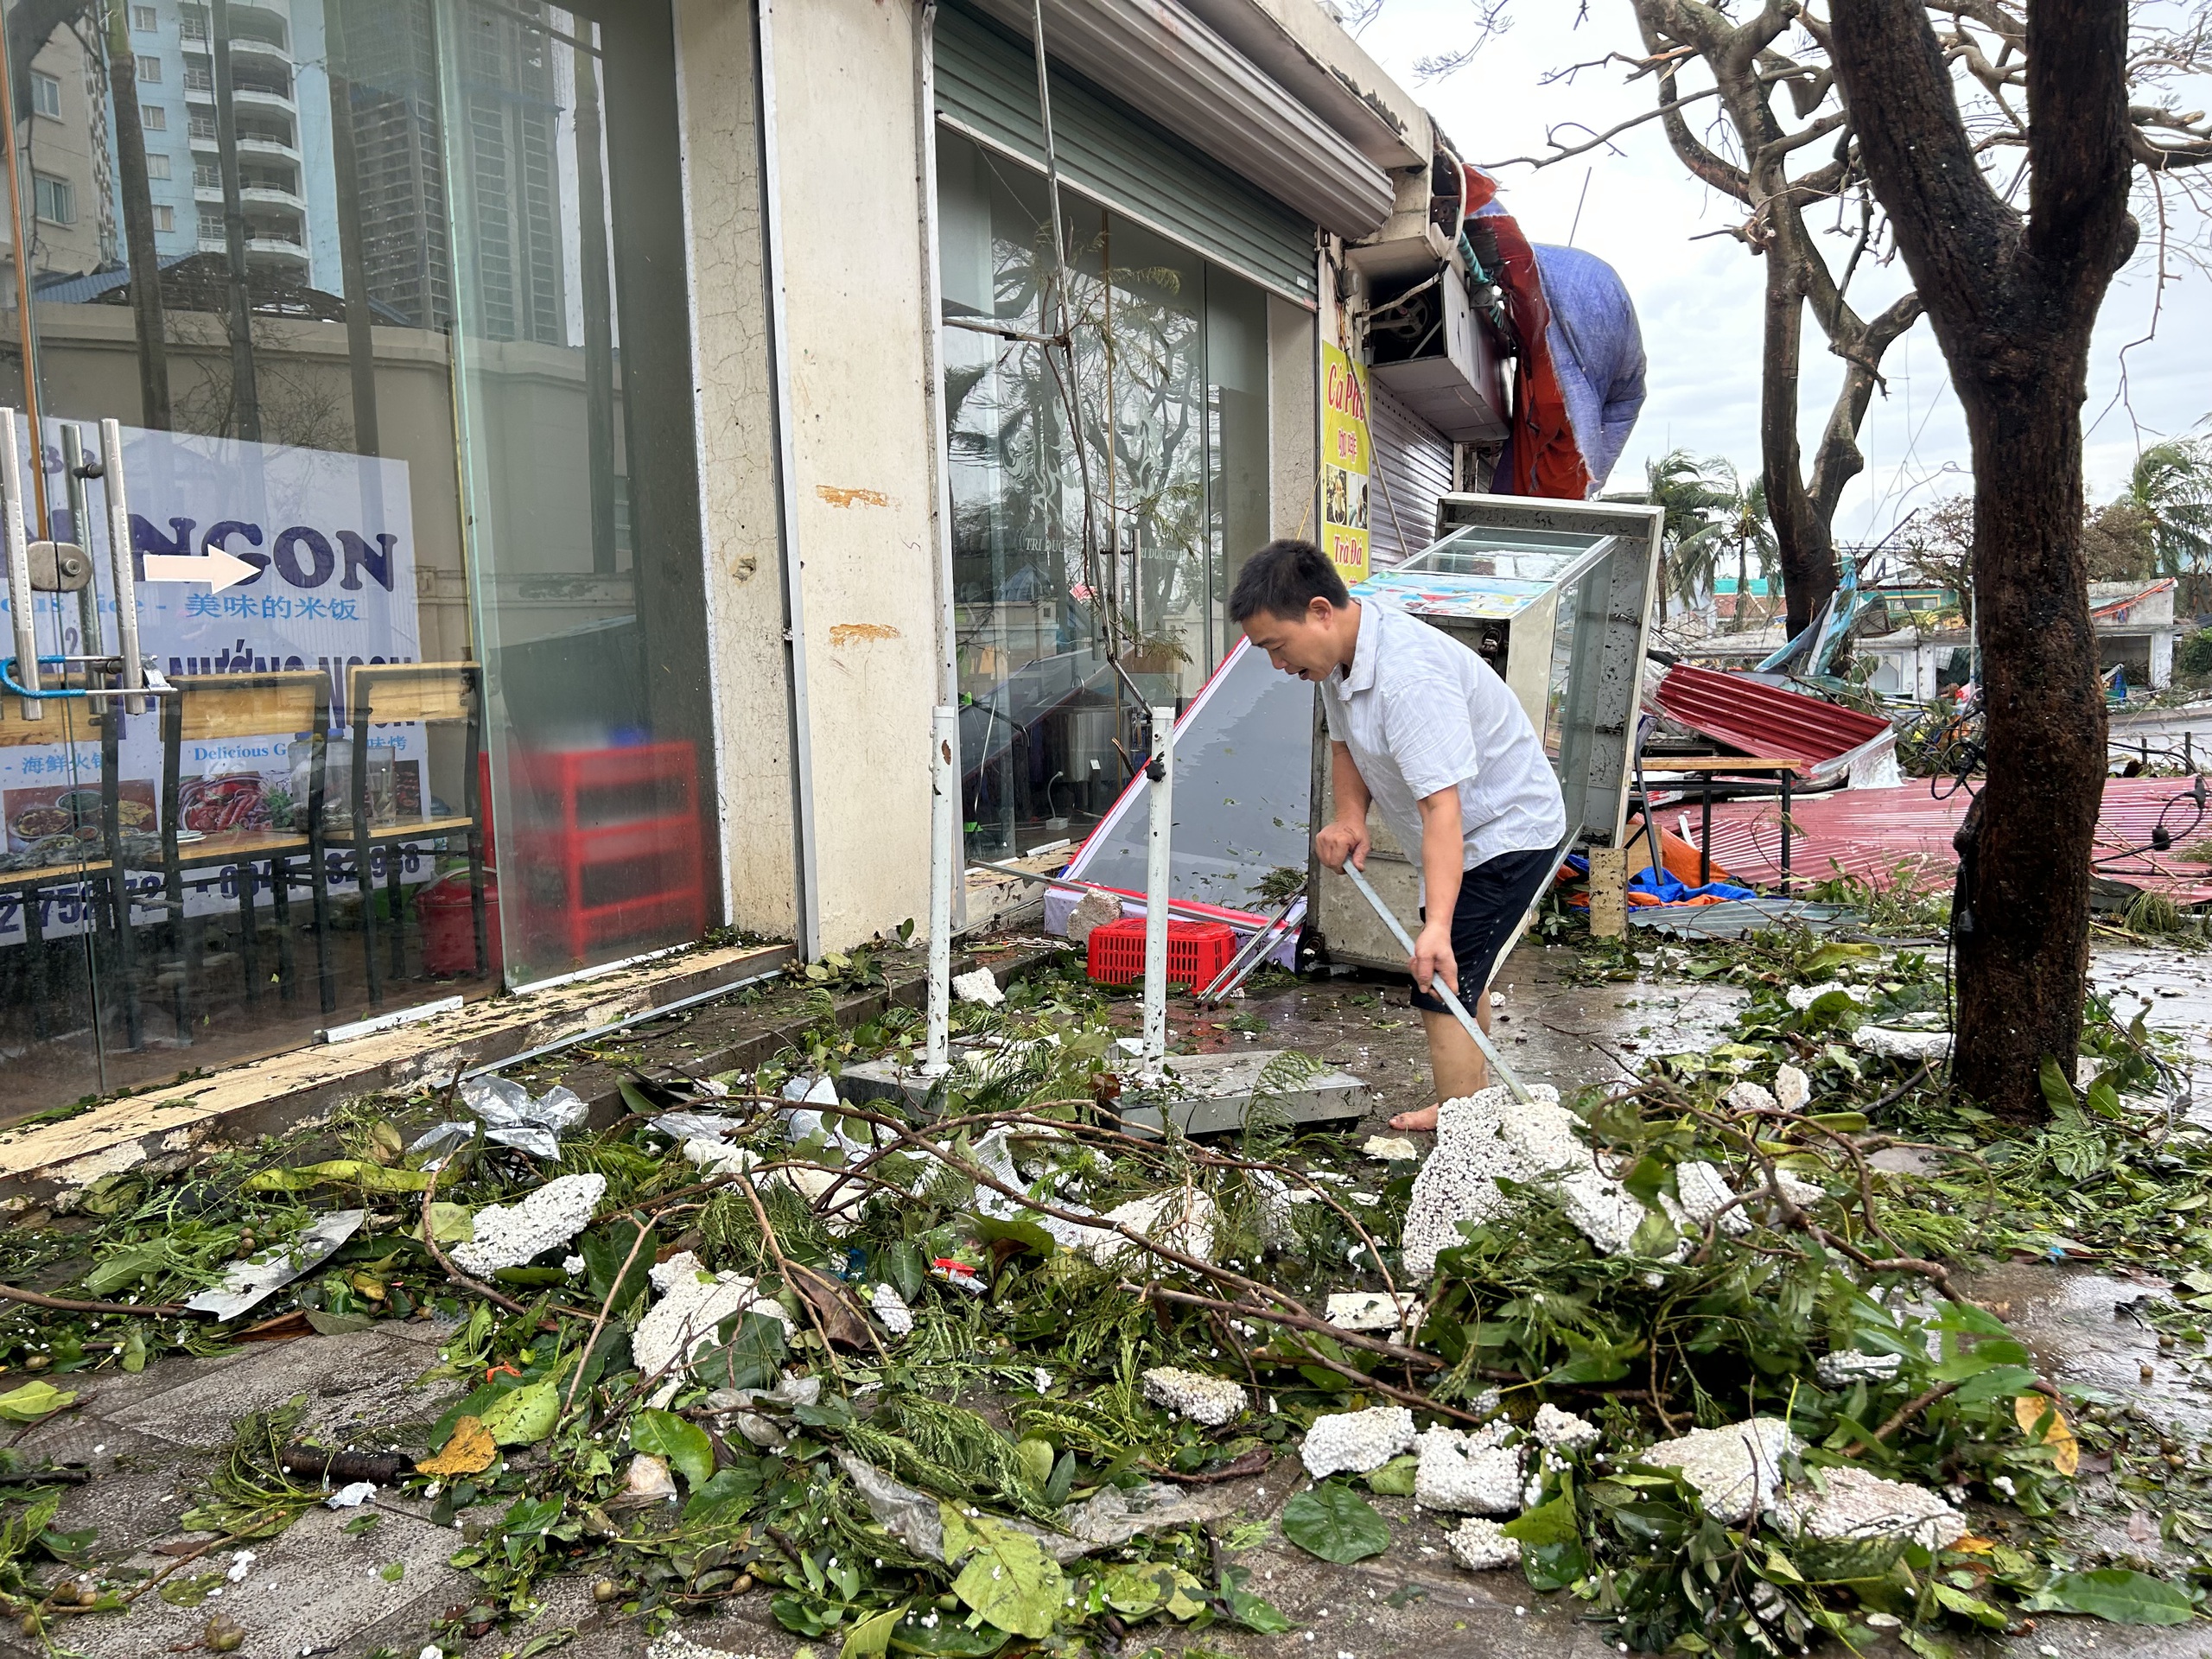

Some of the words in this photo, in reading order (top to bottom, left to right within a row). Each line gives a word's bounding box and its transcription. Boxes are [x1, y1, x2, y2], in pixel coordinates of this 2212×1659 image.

[1338, 429, 1357, 463] 咖啡
[1025, 537, 1044, 551] TRI
[1334, 535, 1350, 564] Trà
[185, 592, 359, 620] 美味的米饭
[194, 744, 269, 761] Delicious
